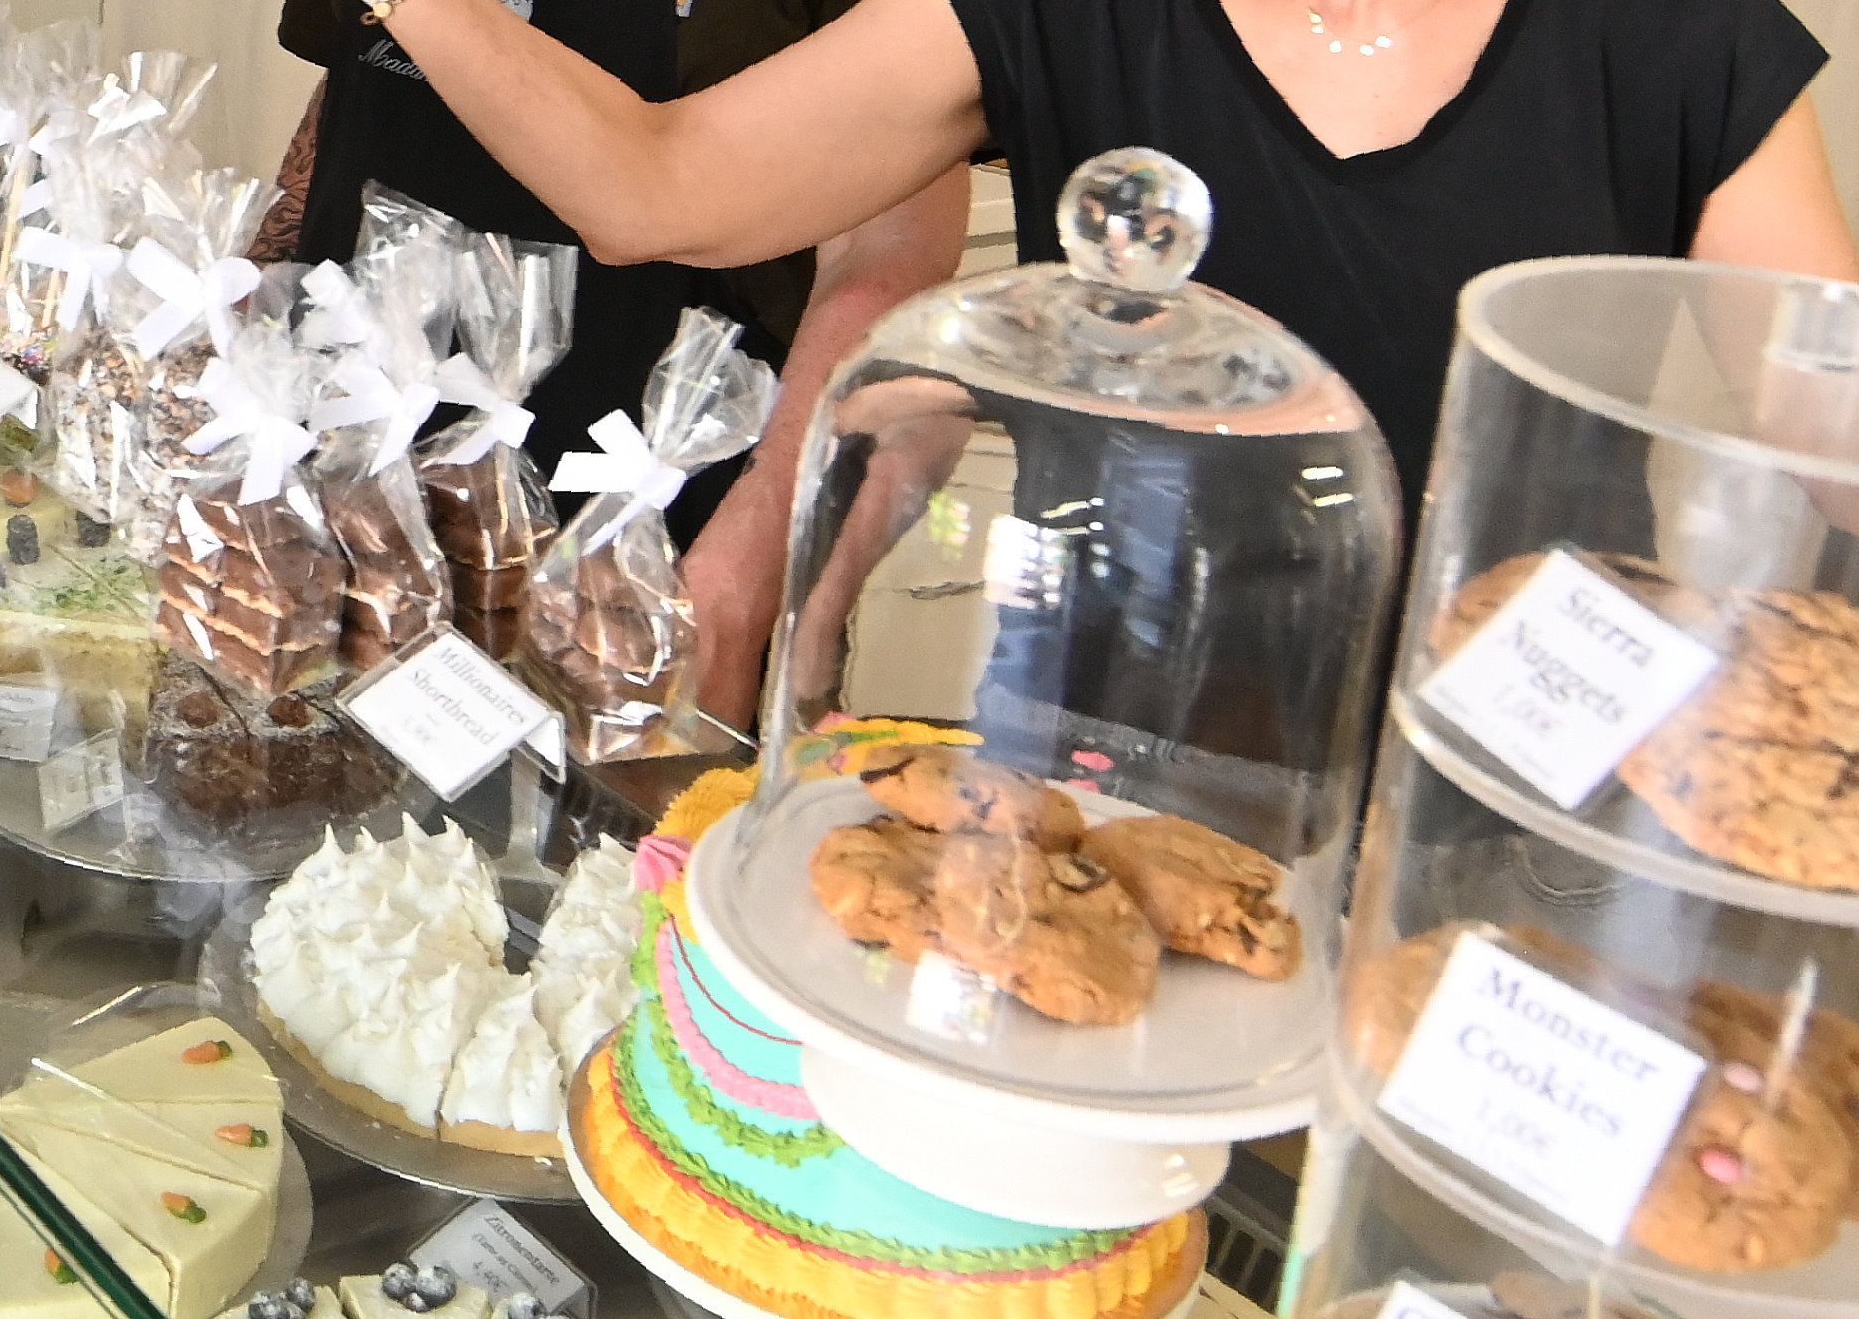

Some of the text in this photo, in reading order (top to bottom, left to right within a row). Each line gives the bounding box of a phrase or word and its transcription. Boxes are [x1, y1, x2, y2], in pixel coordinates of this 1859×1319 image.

[1500, 619, 1631, 725] Nuggets
[1560, 587, 1656, 670] Sierra
[411, 668, 498, 746] Shortbread
[1475, 967, 1660, 1081] Monster
[1455, 1022, 1625, 1139] Cookies
